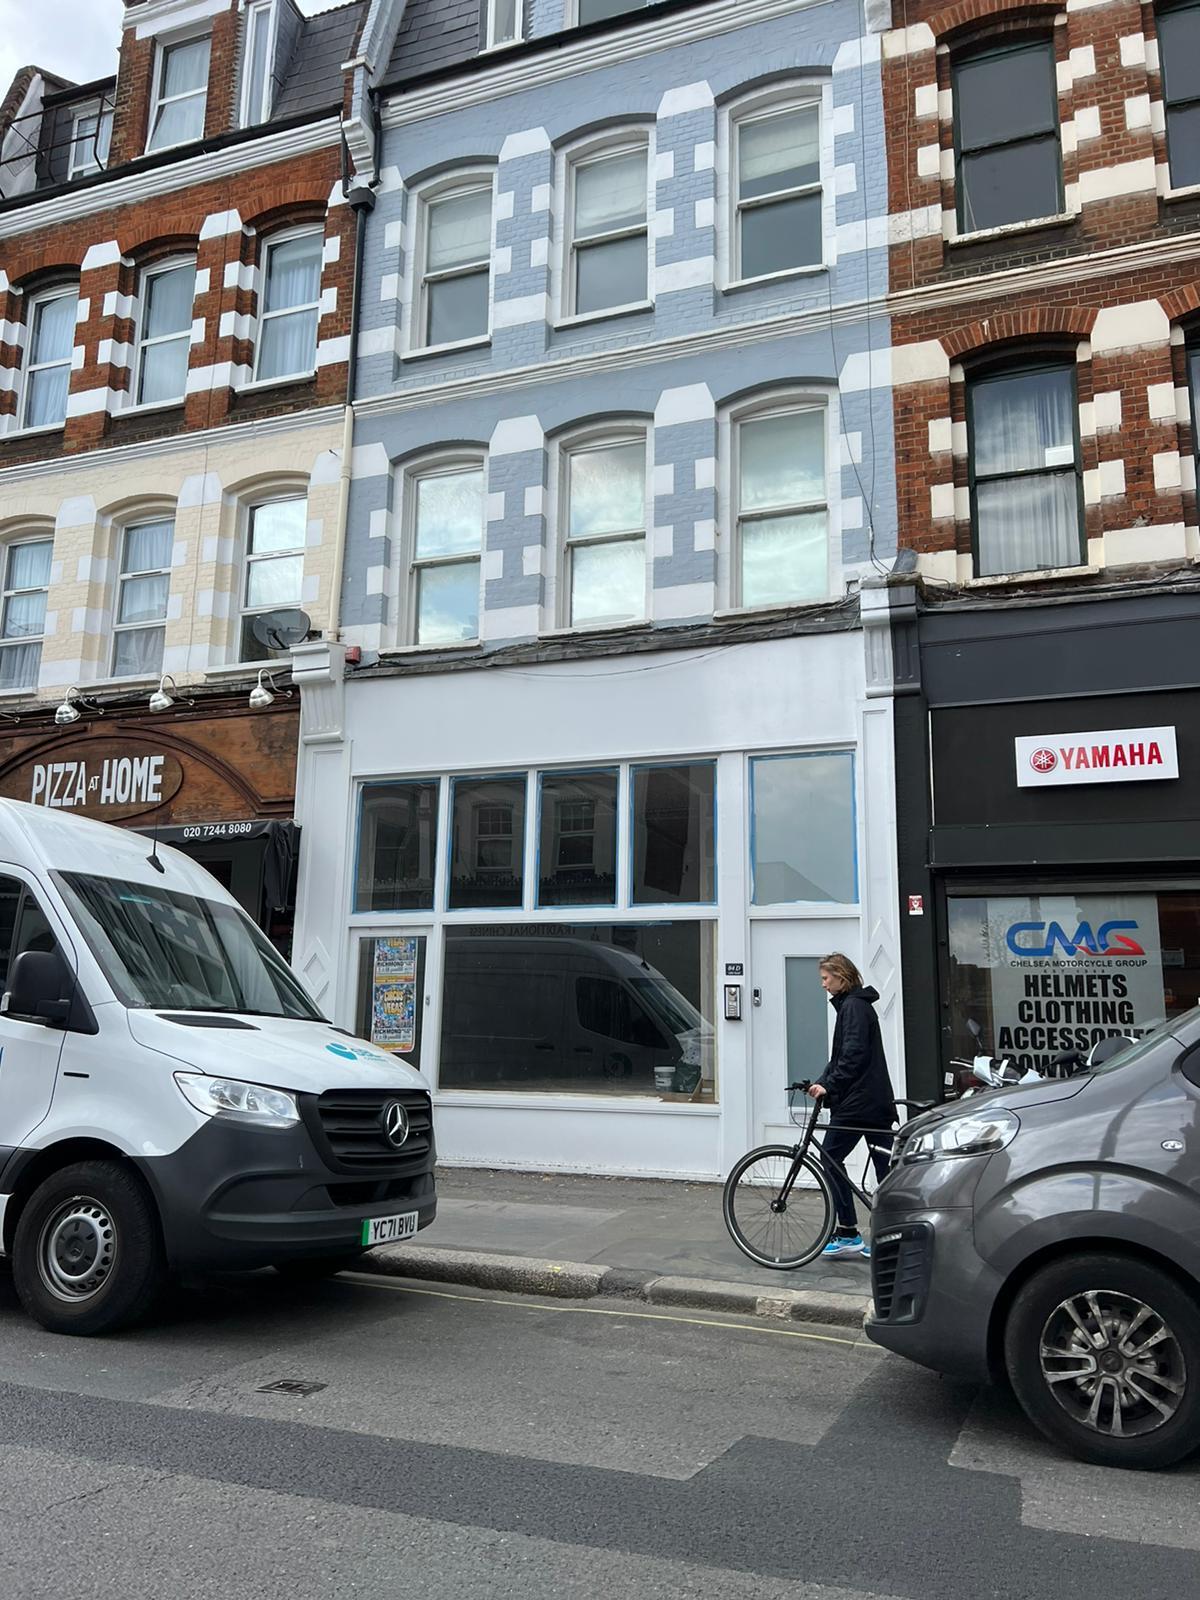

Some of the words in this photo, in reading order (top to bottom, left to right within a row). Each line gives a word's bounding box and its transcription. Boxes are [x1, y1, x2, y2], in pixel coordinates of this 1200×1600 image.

[1060, 742, 1163, 770] YAMAHA
[31, 761, 86, 807] PIZZA
[88, 775, 100, 791] AT
[100, 755, 164, 804] HOME
[183, 826, 201, 838] 020
[203, 824, 226, 836] 7244
[228, 822, 252, 834] 8080
[1006, 920, 1146, 956] CMG
[1011, 960, 1052, 968] CHELSEA
[1053, 959, 1112, 968] MOTORCYCLE
[1115, 959, 1148, 968] GROUP
[1024, 974, 1128, 998] HELMETS
[1018, 1000, 1135, 1025] CLOTHING
[999, 1026, 1156, 1051] ACCESSO
[373, 1218, 397, 1240] YC71
